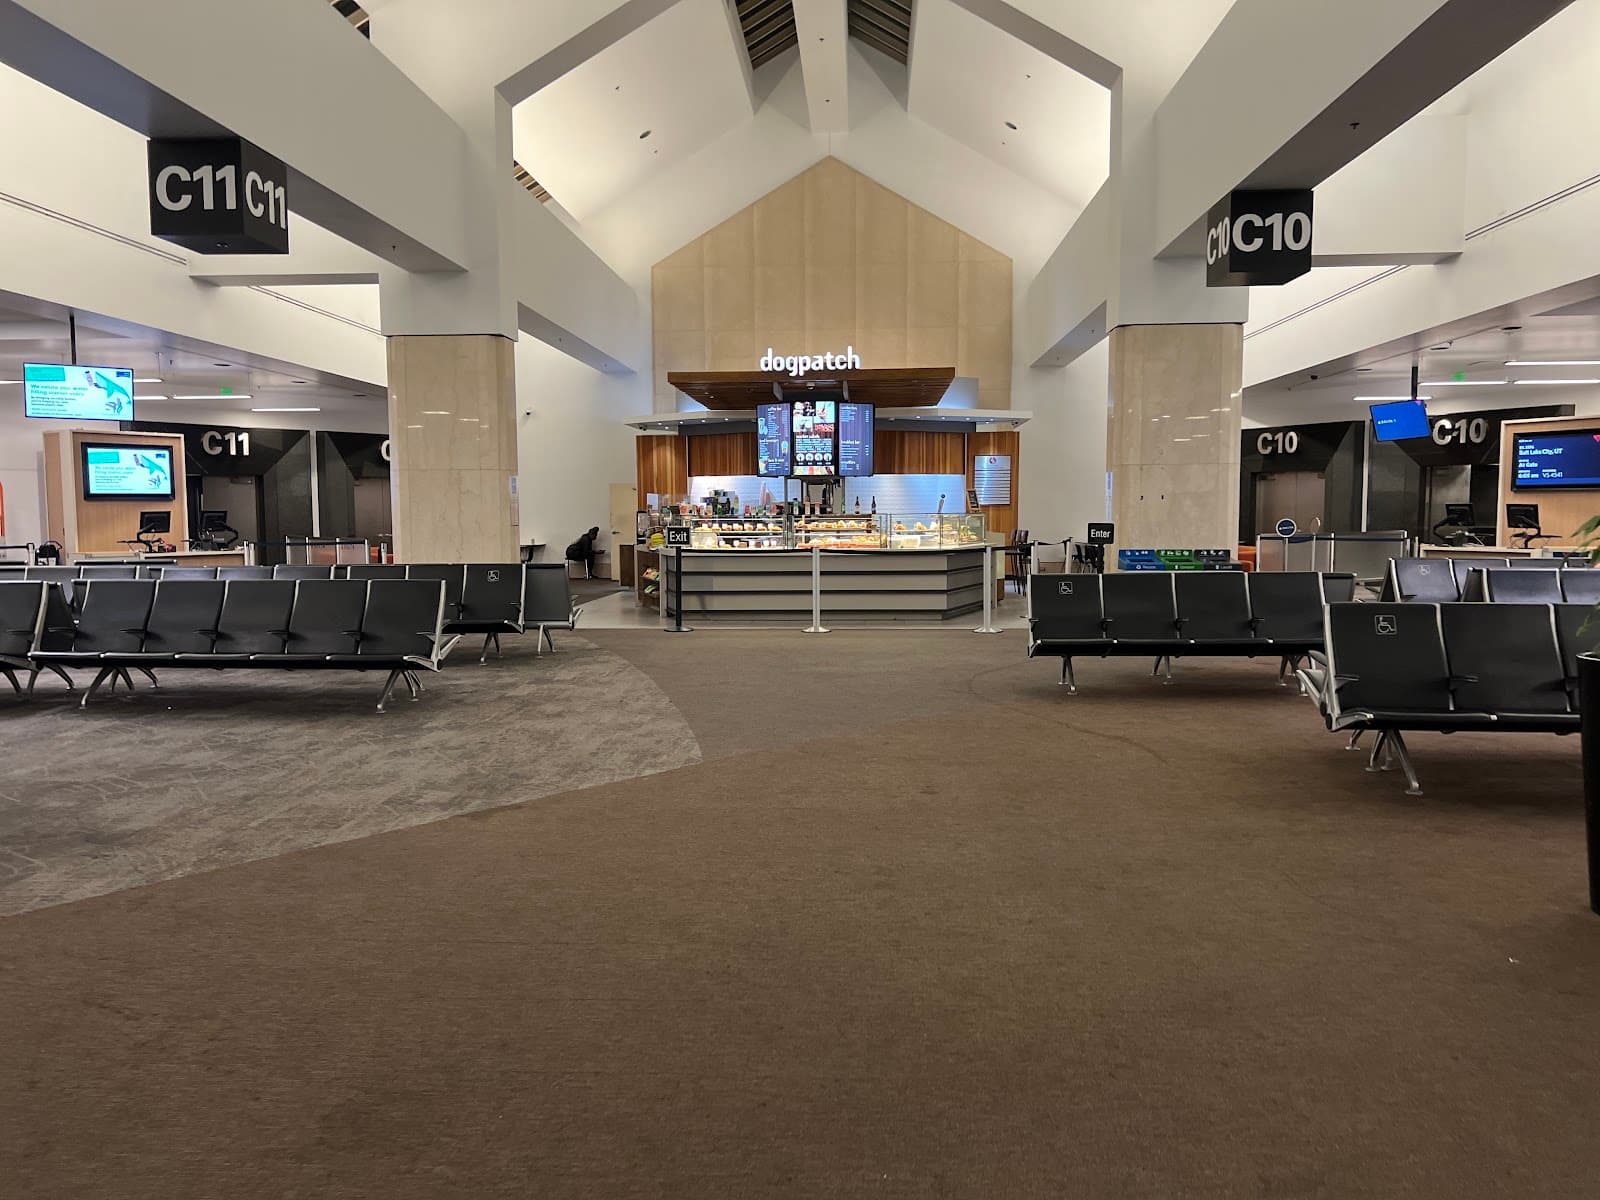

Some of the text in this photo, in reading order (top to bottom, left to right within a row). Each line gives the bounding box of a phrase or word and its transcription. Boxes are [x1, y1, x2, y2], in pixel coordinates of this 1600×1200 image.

[155, 164, 237, 211] C11
[245, 171, 286, 230] C11
[1206, 216, 1231, 266] C10
[1232, 211, 1312, 253] C10
[760, 345, 862, 377] dogpatch
[200, 430, 250, 456] C11
[1256, 431, 1299, 455] C10
[1433, 417, 1488, 446] C10
[669, 531, 688, 542] Exit
[1090, 528, 1112, 538] Enter
